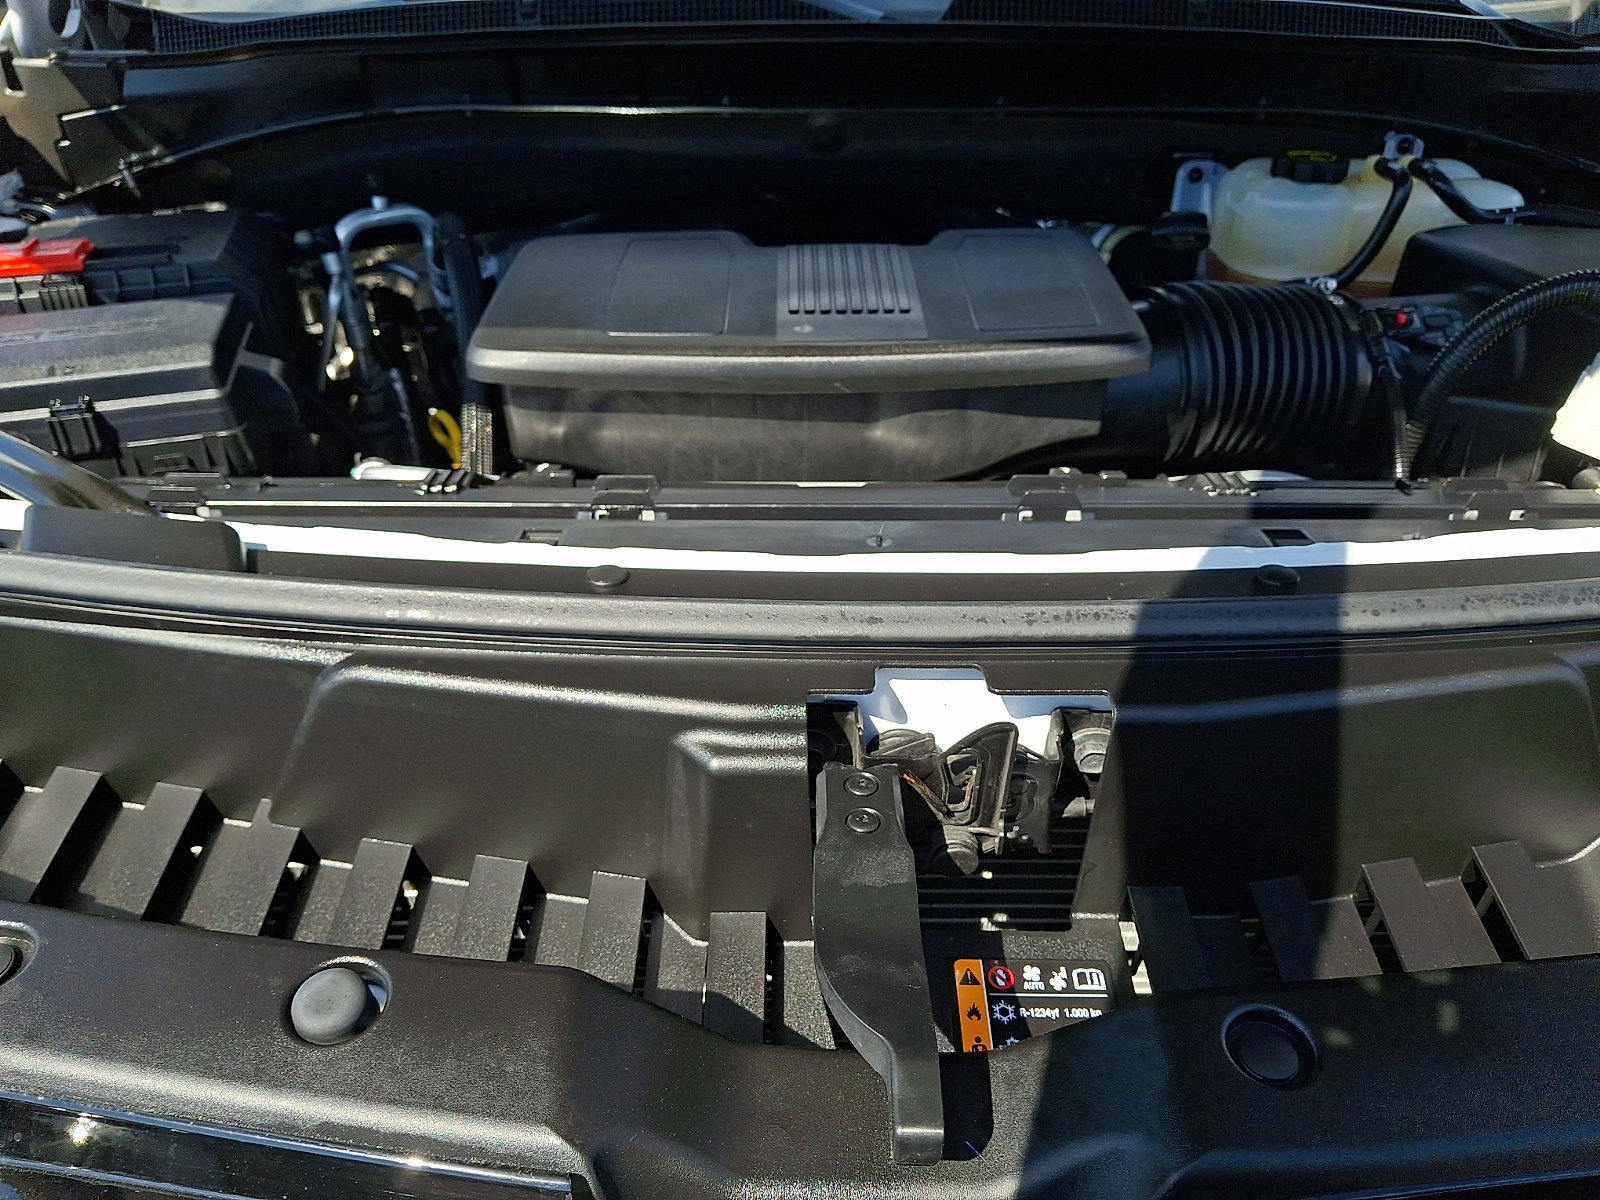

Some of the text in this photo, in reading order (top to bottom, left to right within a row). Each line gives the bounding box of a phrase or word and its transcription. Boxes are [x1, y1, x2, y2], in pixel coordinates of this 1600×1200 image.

[1023, 981, 1045, 991] AUTO
[1019, 1007, 1060, 1019] R-1234yf
[1064, 1008, 1089, 1018] 1.000
